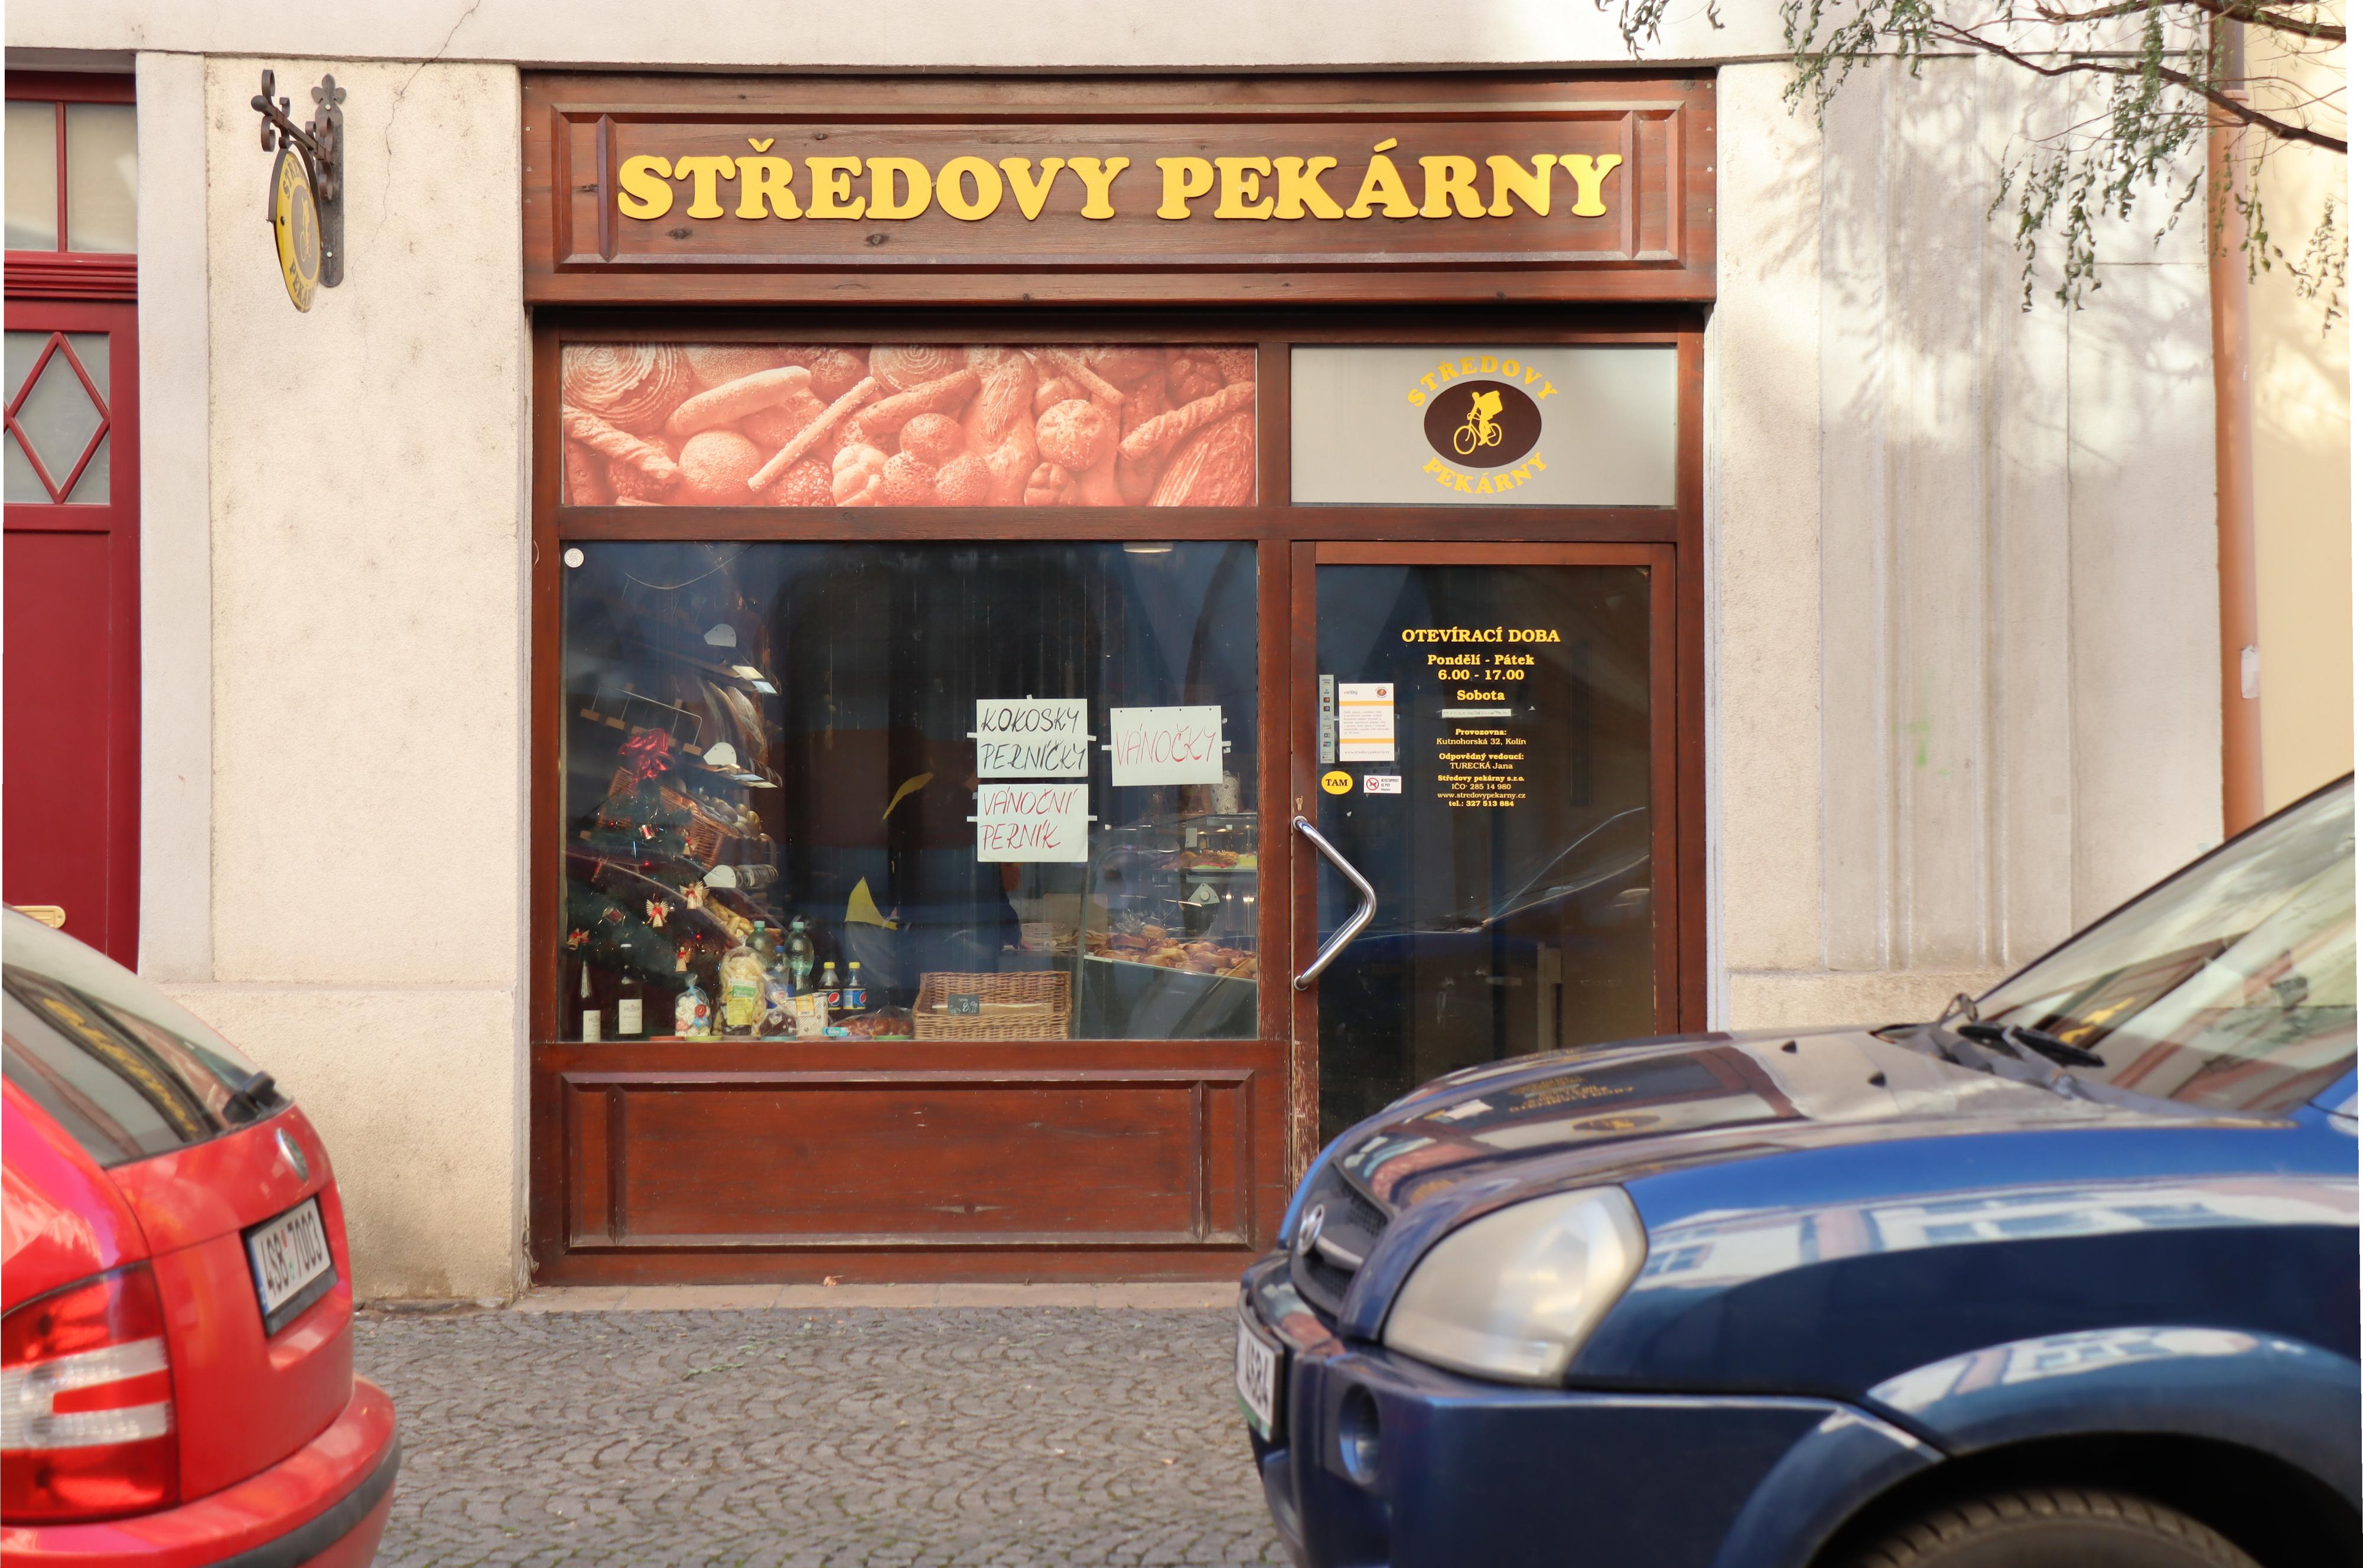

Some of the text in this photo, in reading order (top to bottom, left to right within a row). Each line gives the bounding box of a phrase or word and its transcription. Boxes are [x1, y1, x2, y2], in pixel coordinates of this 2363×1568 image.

[618, 138, 1623, 220] STŘEDOVY PEKÁRNY
[1408, 355, 1558, 407] STŘEDOVY
[1423, 452, 1547, 493] PEKÁRNY
[1401, 626, 1561, 643] OTEVÍRACÍ DOBA
[1427, 654, 1481, 665] Pondělí
[1494, 654, 1535, 665] Pátek
[1438, 669, 1470, 681] 6.00
[1485, 669, 1525, 681] 17.00
[1457, 689, 1506, 701] Sobota
[981, 707, 1079, 734] KOKOSKY
[981, 739, 1086, 771] PERNÍČKY
[1115, 723, 1217, 766] VÁNOČKY
[1438, 753, 1486, 761] Odpovědný
[983, 786, 1078, 816] VÁNOČNÍ
[981, 819, 1062, 851] PERNÍK
